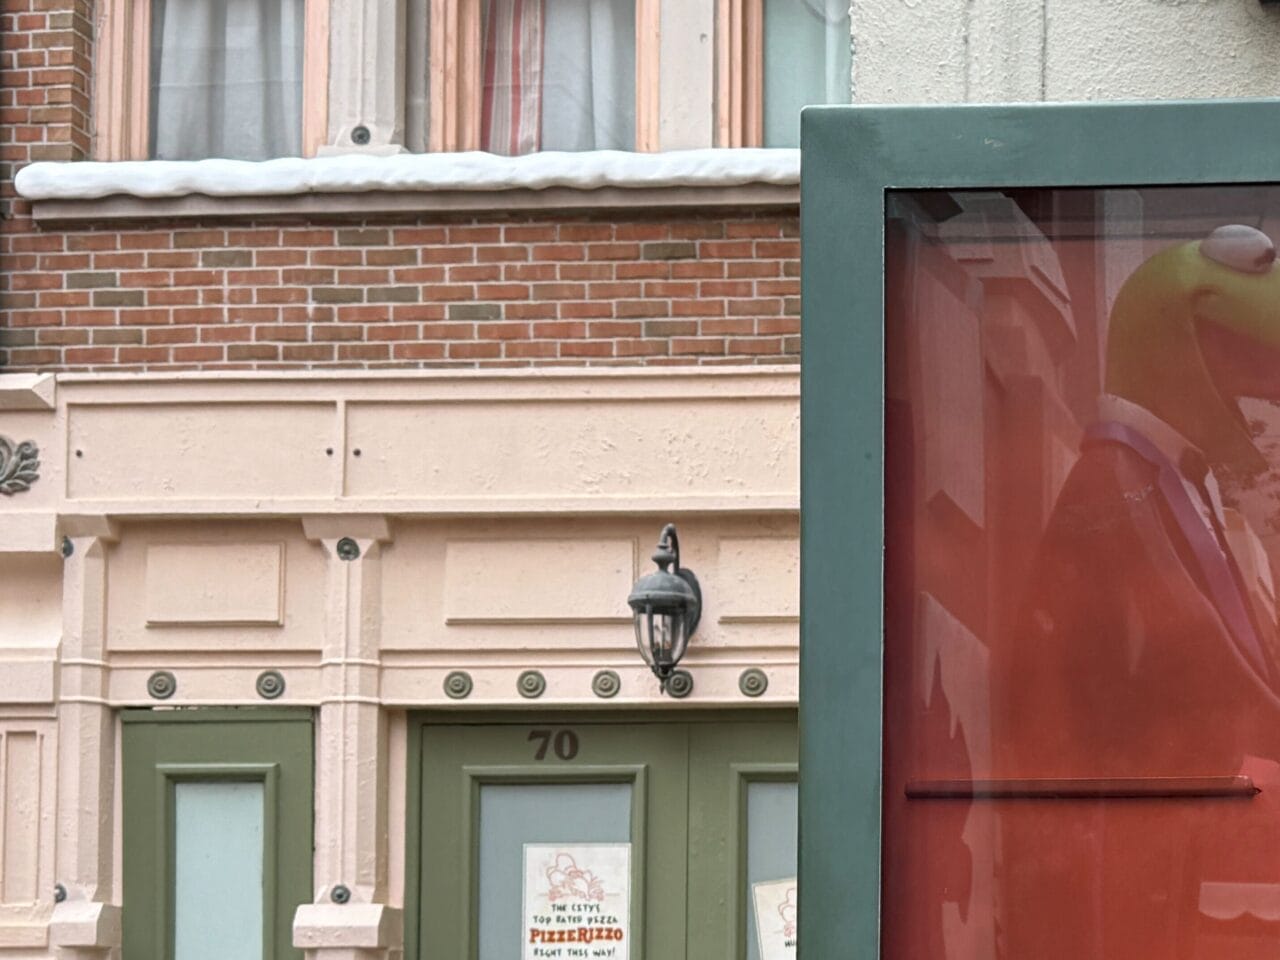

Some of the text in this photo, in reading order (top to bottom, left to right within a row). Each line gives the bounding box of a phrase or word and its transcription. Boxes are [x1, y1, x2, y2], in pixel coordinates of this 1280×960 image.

[527, 729, 579, 761] 70
[551, 903, 567, 912] THE
[533, 915, 619, 925] TOP RATED PIZZA
[529, 927, 623, 944] PIZZERIZZO
[533, 946, 616, 958] RIGHT THIS WAY!
